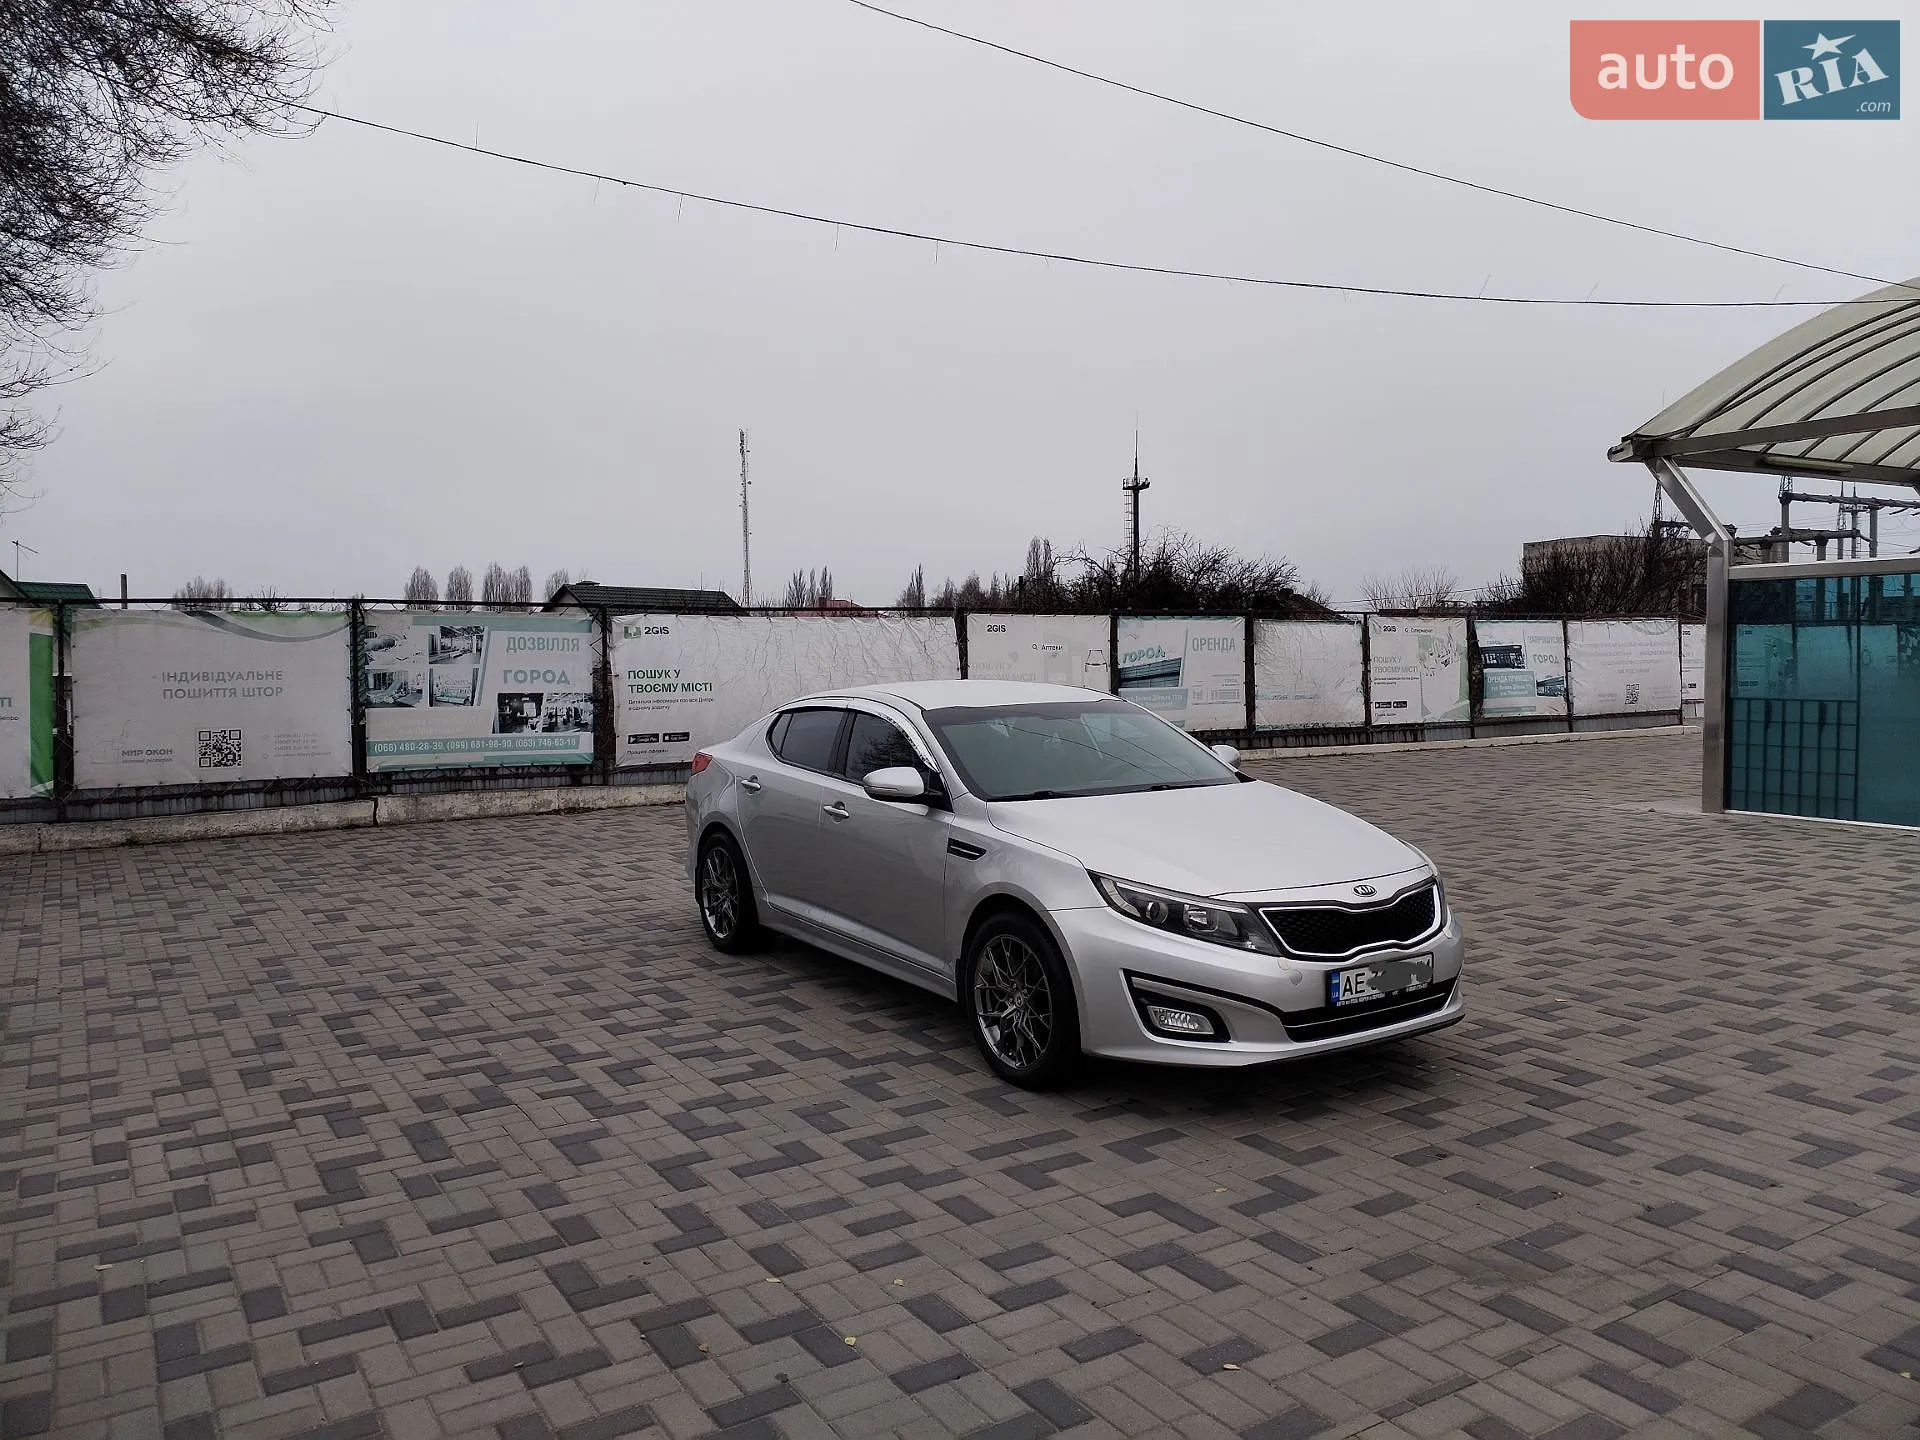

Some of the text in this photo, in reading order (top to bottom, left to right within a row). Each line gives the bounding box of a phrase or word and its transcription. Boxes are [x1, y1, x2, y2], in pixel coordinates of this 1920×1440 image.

[643, 626, 670, 636] 2GIS
[986, 624, 1007, 633] 2GIS
[505, 636, 580, 653] ДОЗВІЛЛЯ
[1192, 637, 1236, 653] ОРЕНДА
[1122, 644, 1166, 664] ГОРОД
[161, 670, 283, 684] ІНДИВІДУАЛЬНЕ
[503, 669, 571, 685] ГОРОД
[627, 669, 681, 681] ПОШУК У
[162, 686, 284, 700] ПОШИТТЯ ШТОР
[628, 682, 713, 693] ТВОЄМУ МІСТІ
[447, 741, 468, 751] (099)
[120, 748, 173, 757] МИР ОКОН
[1355, 885, 1376, 896] KIA
